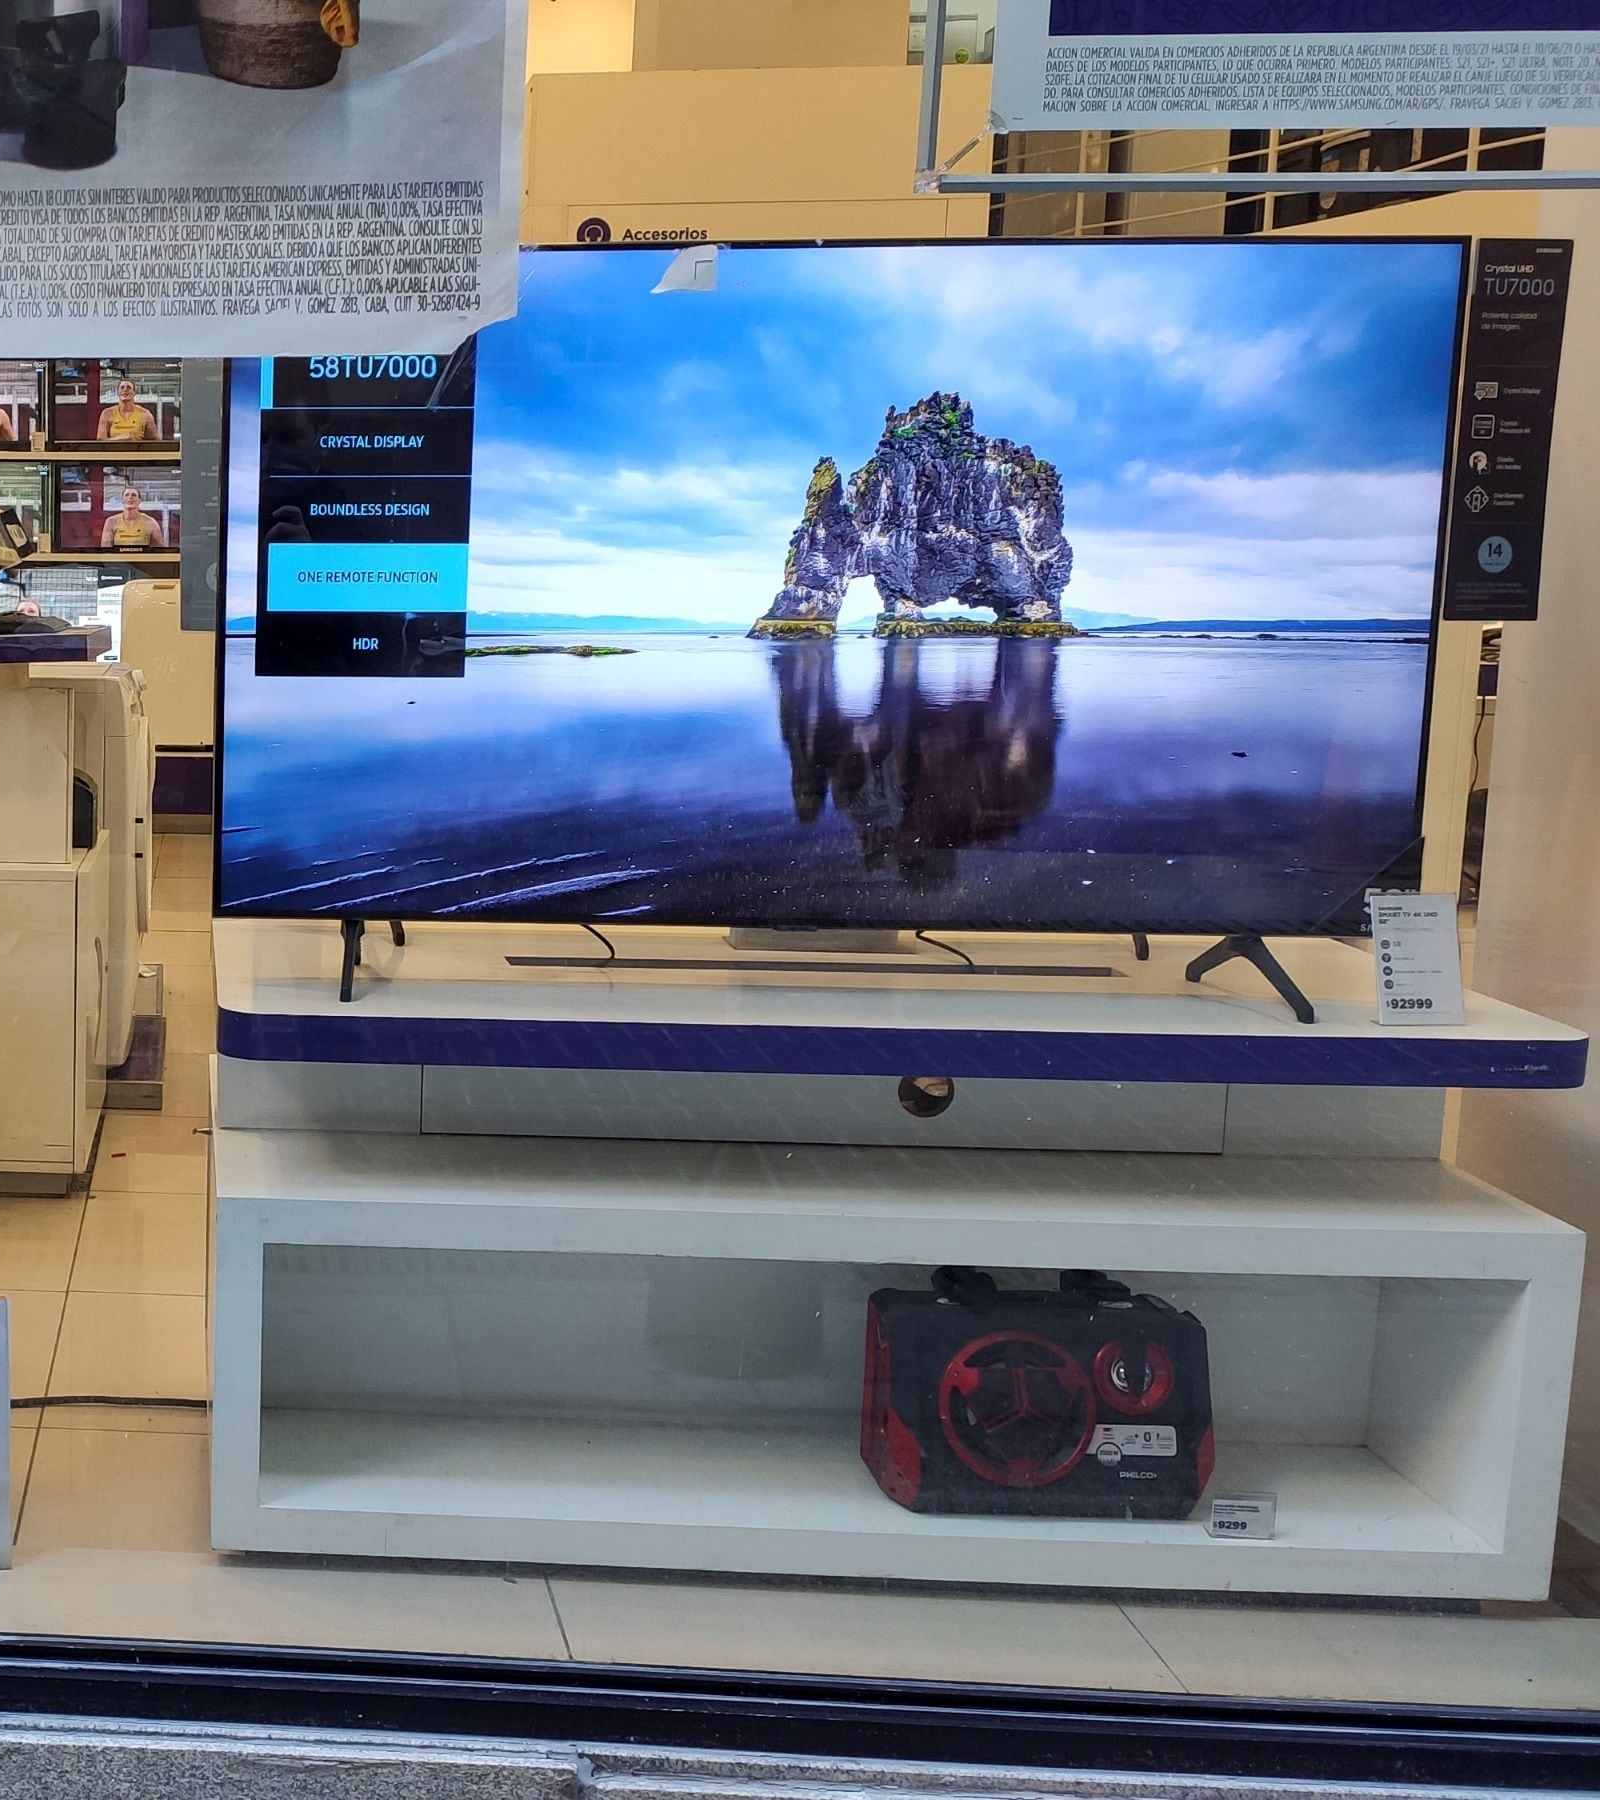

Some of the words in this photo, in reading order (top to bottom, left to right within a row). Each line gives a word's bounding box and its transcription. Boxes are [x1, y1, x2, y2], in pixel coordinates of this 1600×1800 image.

[1047, 47, 1078, 59] ACCION
[1080, 46, 1127, 59] COMERCIAL
[1130, 46, 1160, 58] VALIDA
[1162, 46, 1174, 58] EN
[1176, 45, 1225, 58] COMERCIOS
[1227, 45, 1277, 58] ADHERIDOS
[1280, 45, 1291, 57] DE
[1293, 45, 1304, 57] LA
[1306, 44, 1354, 57] REPUBLICA
[1356, 44, 1407, 57] ARGENTINA
[1409, 43, 1438, 56] DESDE
[1440, 43, 1449, 56] EL
[1491, 42, 1519, 55] HASTA
[1045, 61, 1074, 72] DADES
[1077, 61, 1088, 72] DE
[1091, 60, 1106, 72] LOS
[1110, 60, 1149, 72] MODELOS
[1153, 59, 1219, 72] PARTICIPANTES,
[1222, 59, 1233, 71] LO
[1236, 59, 1254, 71] QUE
[1257, 58, 1293, 71] OCURRA
[1341, 57, 1381, 70] MODELOS
[1087, 73, 1136, 85] COTIZACION
[1139, 73, 1162, 85] FINAL
[1165, 73, 1176, 85] DE
[1179, 73, 1189, 85] TU
[1191, 72, 1228, 84] CELULAR
[1230, 72, 1260, 84] USADO
[1061, 87, 1084, 98] PARA
[1086, 87, 1135, 98] CONSULTAR
[1043, 101, 1076, 112] MACION
[1080, 101, 1108, 112] SOBRE
[1111, 101, 1122, 112] LA
[1126, 100, 1158, 112] ACCION
[1215, 99, 1259, 111] INGRESAR
[1262, 100, 1269, 111] A
[137, 187, 166, 204] VALIDO
[168, 187, 190, 203] PARA
[193, 186, 240, 203] PRODUCTOS
[242, 185, 307, 203] SELECCIONADOS
[308, 184, 361, 201] UNICAMENTE
[363, 183, 385, 200] PARA
[387, 183, 402, 199] LAS
[403, 182, 443, 199] TARJETAS
[445, 181, 483, 198] EMITIDAS
[297, 203, 334, 220] NOMINAL
[336, 202, 364, 219] ANUAL
[366, 202, 389, 220] (TNA)
[423, 200, 443, 217] TASA
[445, 200, 482, 217] EFECTIVA
[622, 226, 708, 241] Accesorios
[1484, 264, 1516, 275] Crystal
[1517, 264, 1534, 273] UHD
[1483, 278, 1554, 296] TU7000
[122, 300, 156, 317] EFECTOS
[222, 298, 261, 315] FRAVEGA
[307, 297, 336, 314] GOMEZ
[365, 295, 389, 314] CABA,
[395, 295, 412, 312] CUIT
[308, 355, 437, 379] 58TU7000
[319, 435, 371, 449] CRYSTAL
[374, 435, 425, 449] DISPLAY
[310, 503, 382, 517] BOUNDLESS
[385, 503, 430, 517] DESIGN
[1487, 543, 1503, 558] 14
[297, 571, 323, 584] ONE
[325, 571, 374, 584] REMOTE
[377, 571, 438, 584] FUNCTION
[352, 637, 379, 650] HDR
[1386, 997, 1433, 1010] $92999
[1119, 1471, 1154, 1480] PHILCO
[1213, 1520, 1247, 1531] $9299
